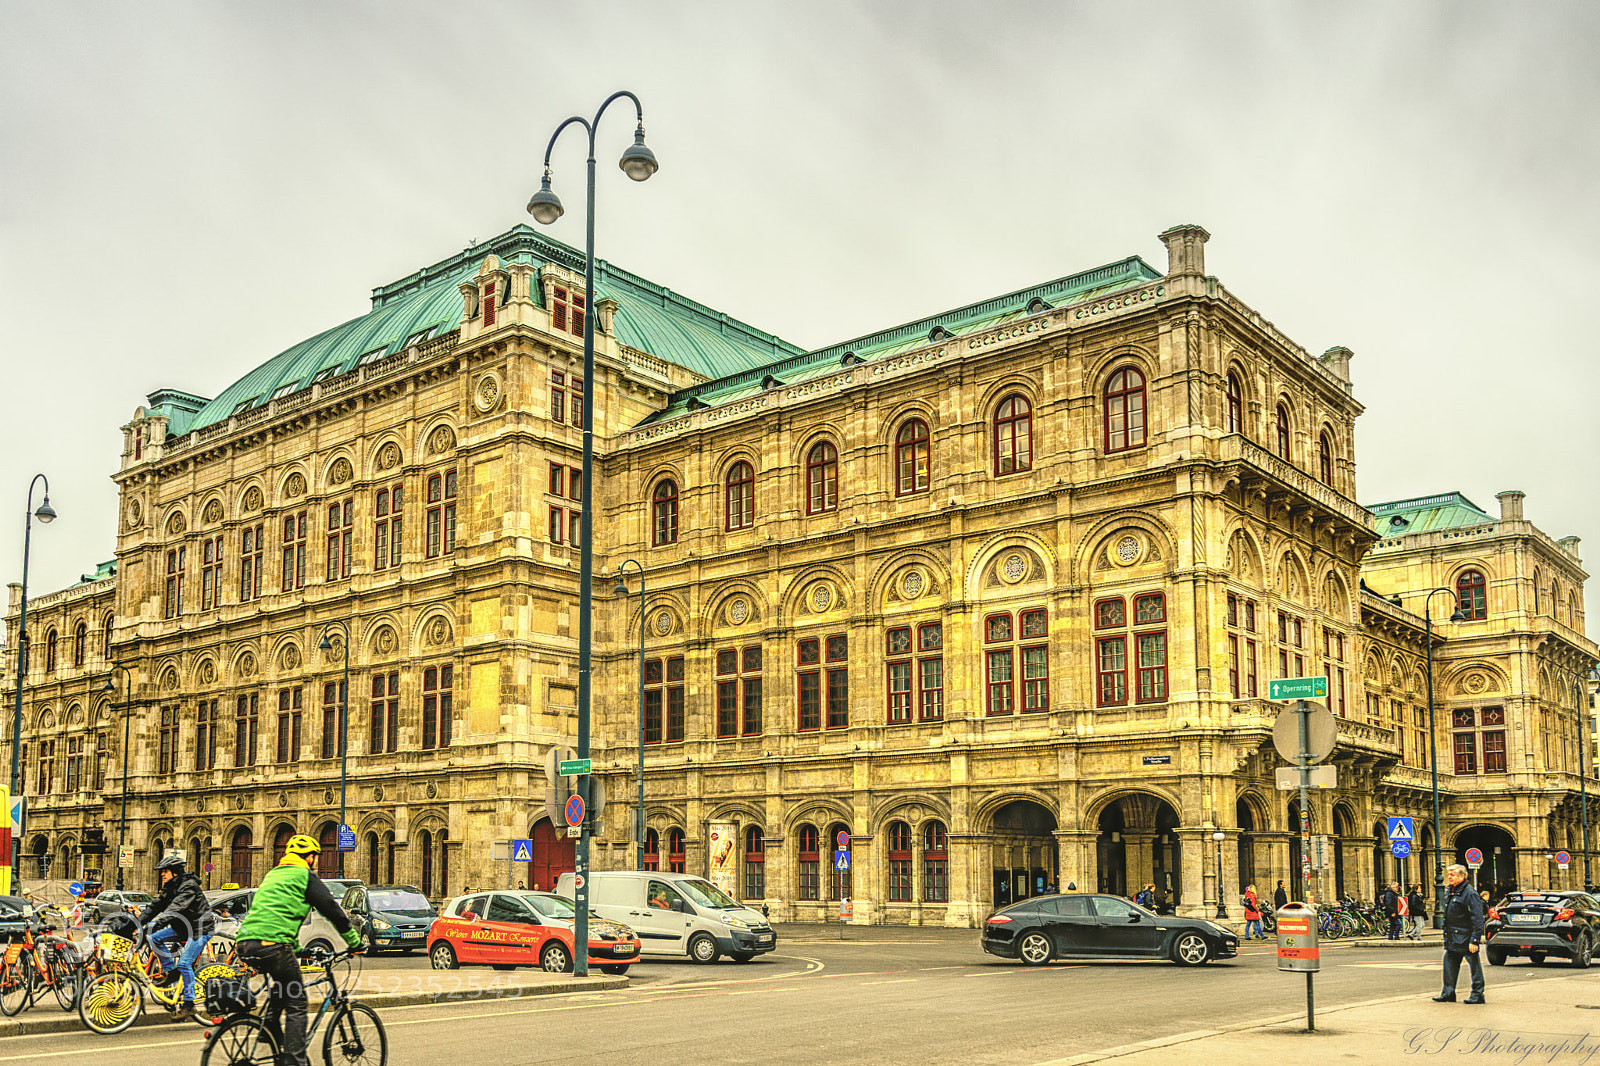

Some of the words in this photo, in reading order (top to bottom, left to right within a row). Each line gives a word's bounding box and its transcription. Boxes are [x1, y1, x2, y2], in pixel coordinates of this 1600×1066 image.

[1283, 686, 1311, 694] Opernring
[471, 930, 508, 941] MOZART
[211, 941, 236, 955] TAX
